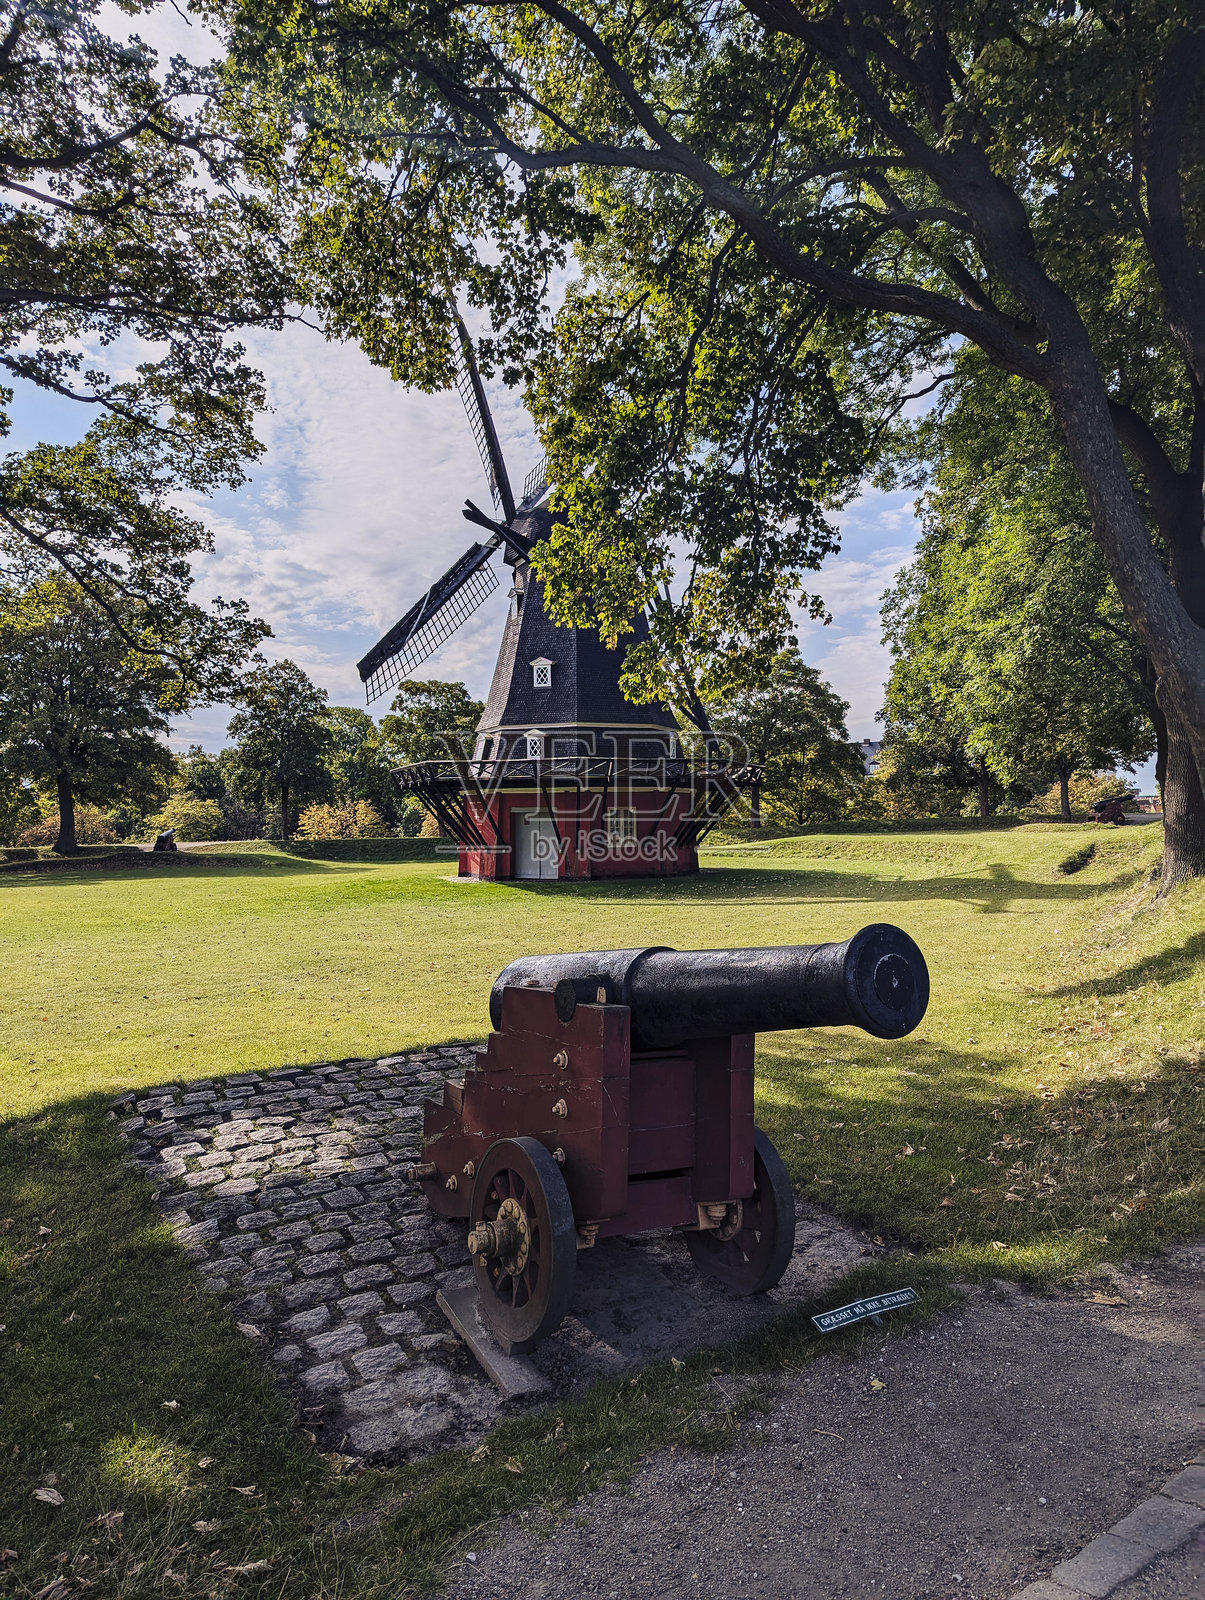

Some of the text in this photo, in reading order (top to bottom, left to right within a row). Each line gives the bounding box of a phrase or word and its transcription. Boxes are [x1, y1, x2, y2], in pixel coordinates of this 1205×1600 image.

[821, 1310, 853, 1325] GRÆSSET
[854, 1304, 866, 1314] MÅ
[866, 1300, 881, 1310] IKKE
